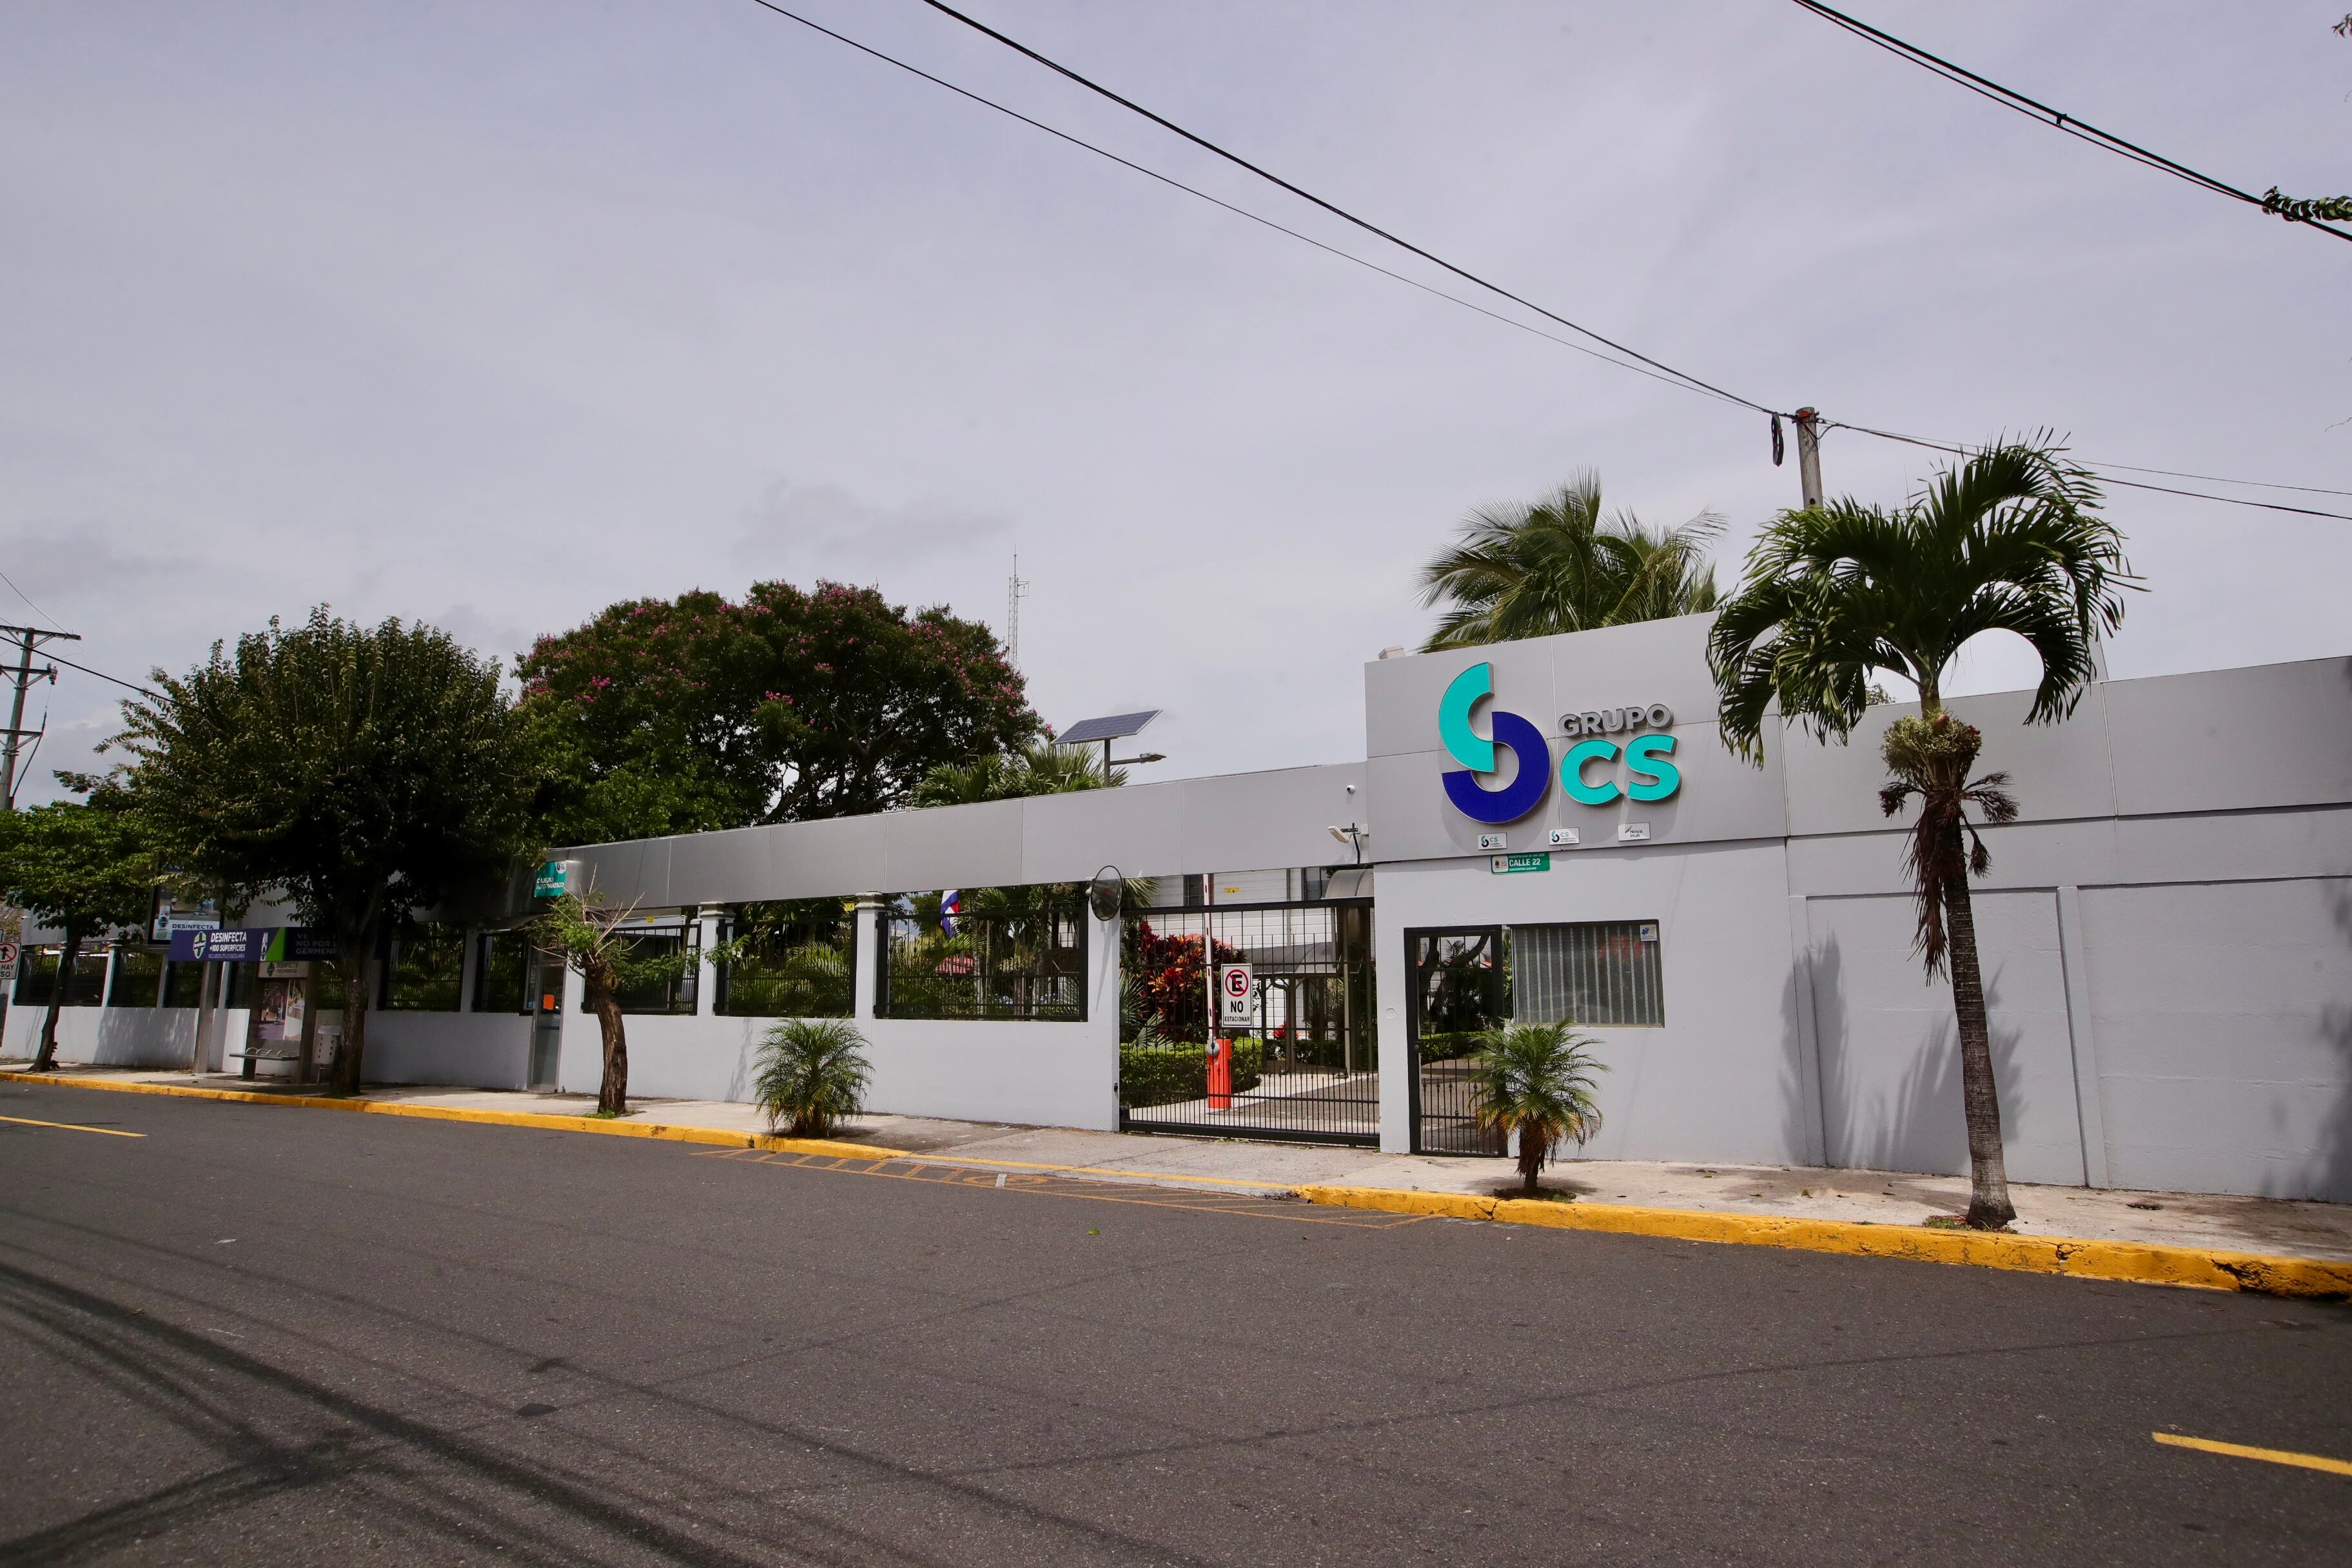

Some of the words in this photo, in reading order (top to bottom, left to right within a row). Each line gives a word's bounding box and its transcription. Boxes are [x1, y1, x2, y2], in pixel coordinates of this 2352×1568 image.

[1558, 703, 1673, 736] GRUPO
[1560, 734, 1681, 805] CS
[210, 932, 247, 943] DESINFECTA
[1230, 1001, 1244, 1013] NO
